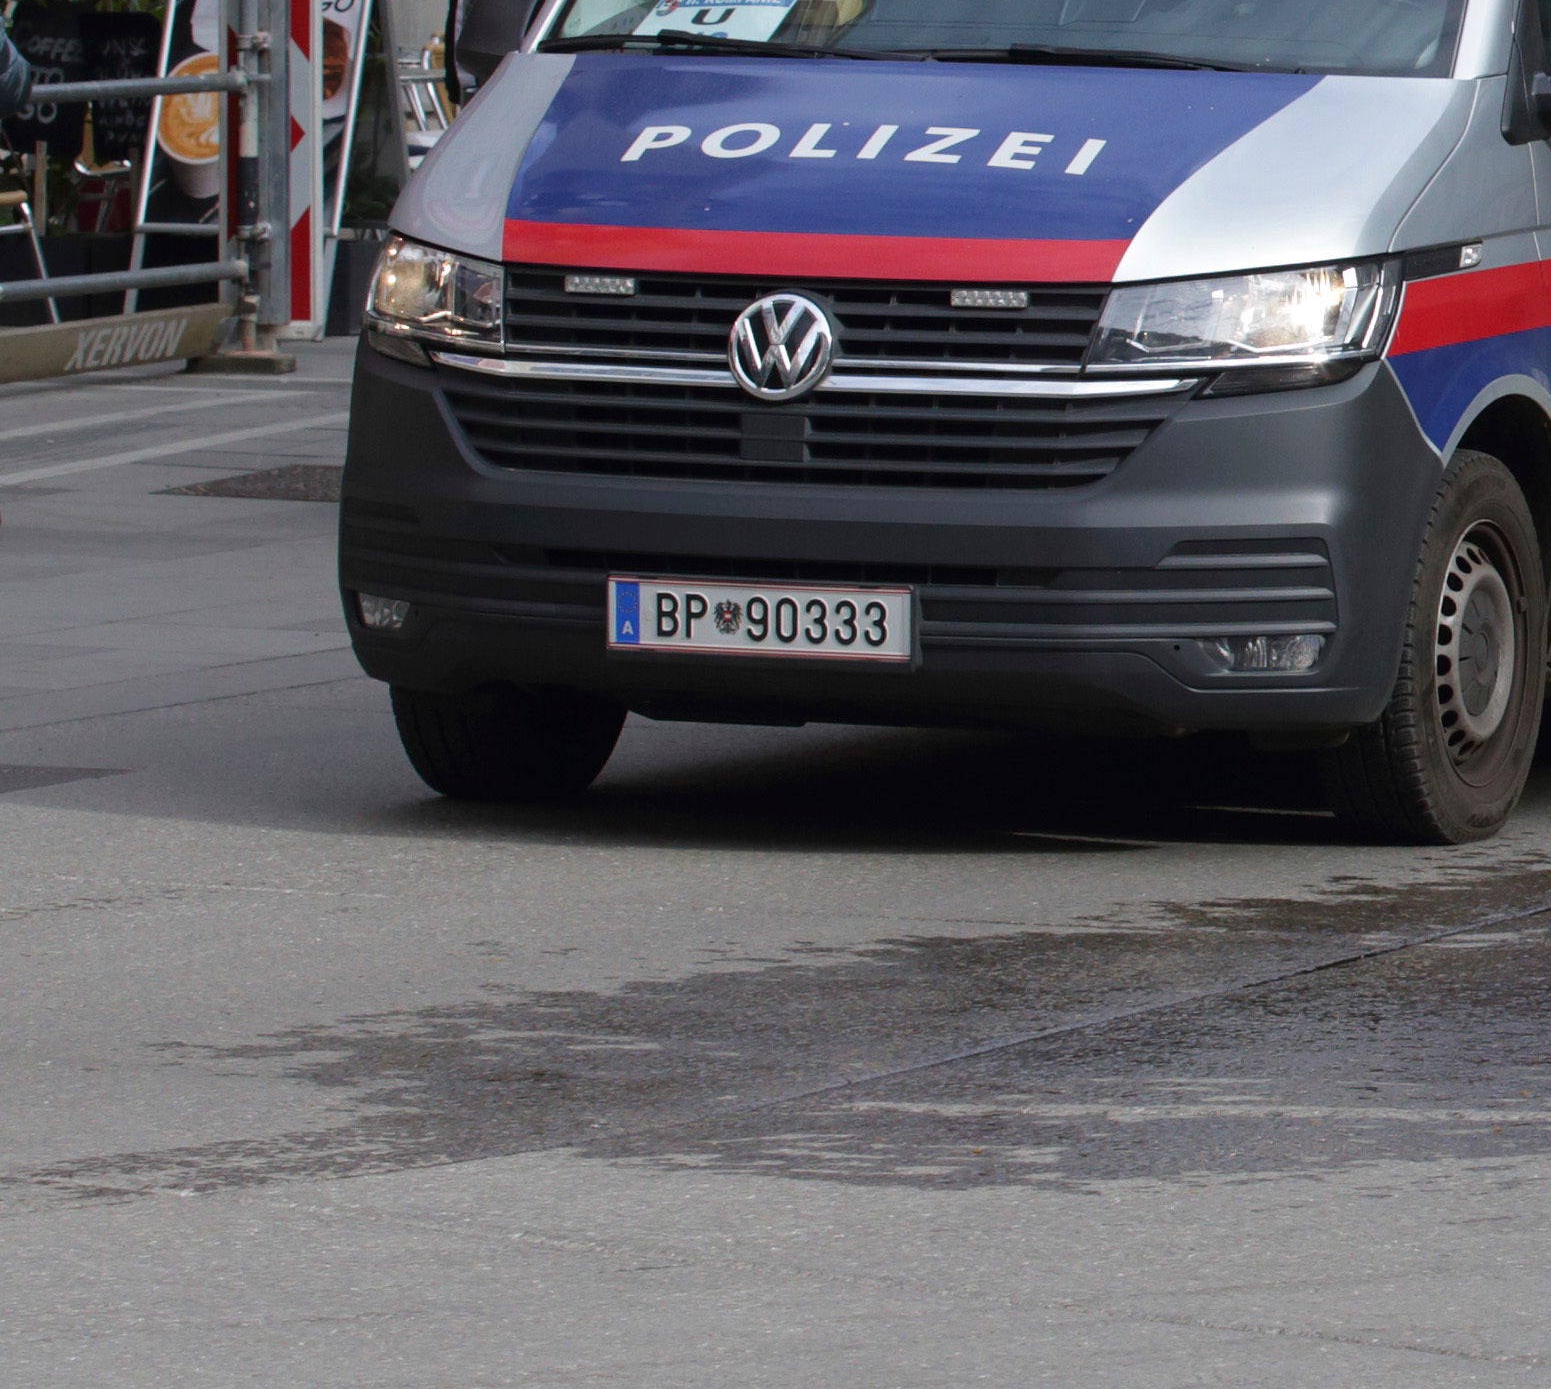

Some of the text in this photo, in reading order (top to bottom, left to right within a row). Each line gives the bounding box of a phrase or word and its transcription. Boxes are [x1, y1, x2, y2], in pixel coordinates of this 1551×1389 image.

[621, 122, 1107, 176] POLIZEI
[63, 317, 189, 371] XERVON
[621, 621, 634, 635] A
[656, 592, 888, 646] BP 90333
